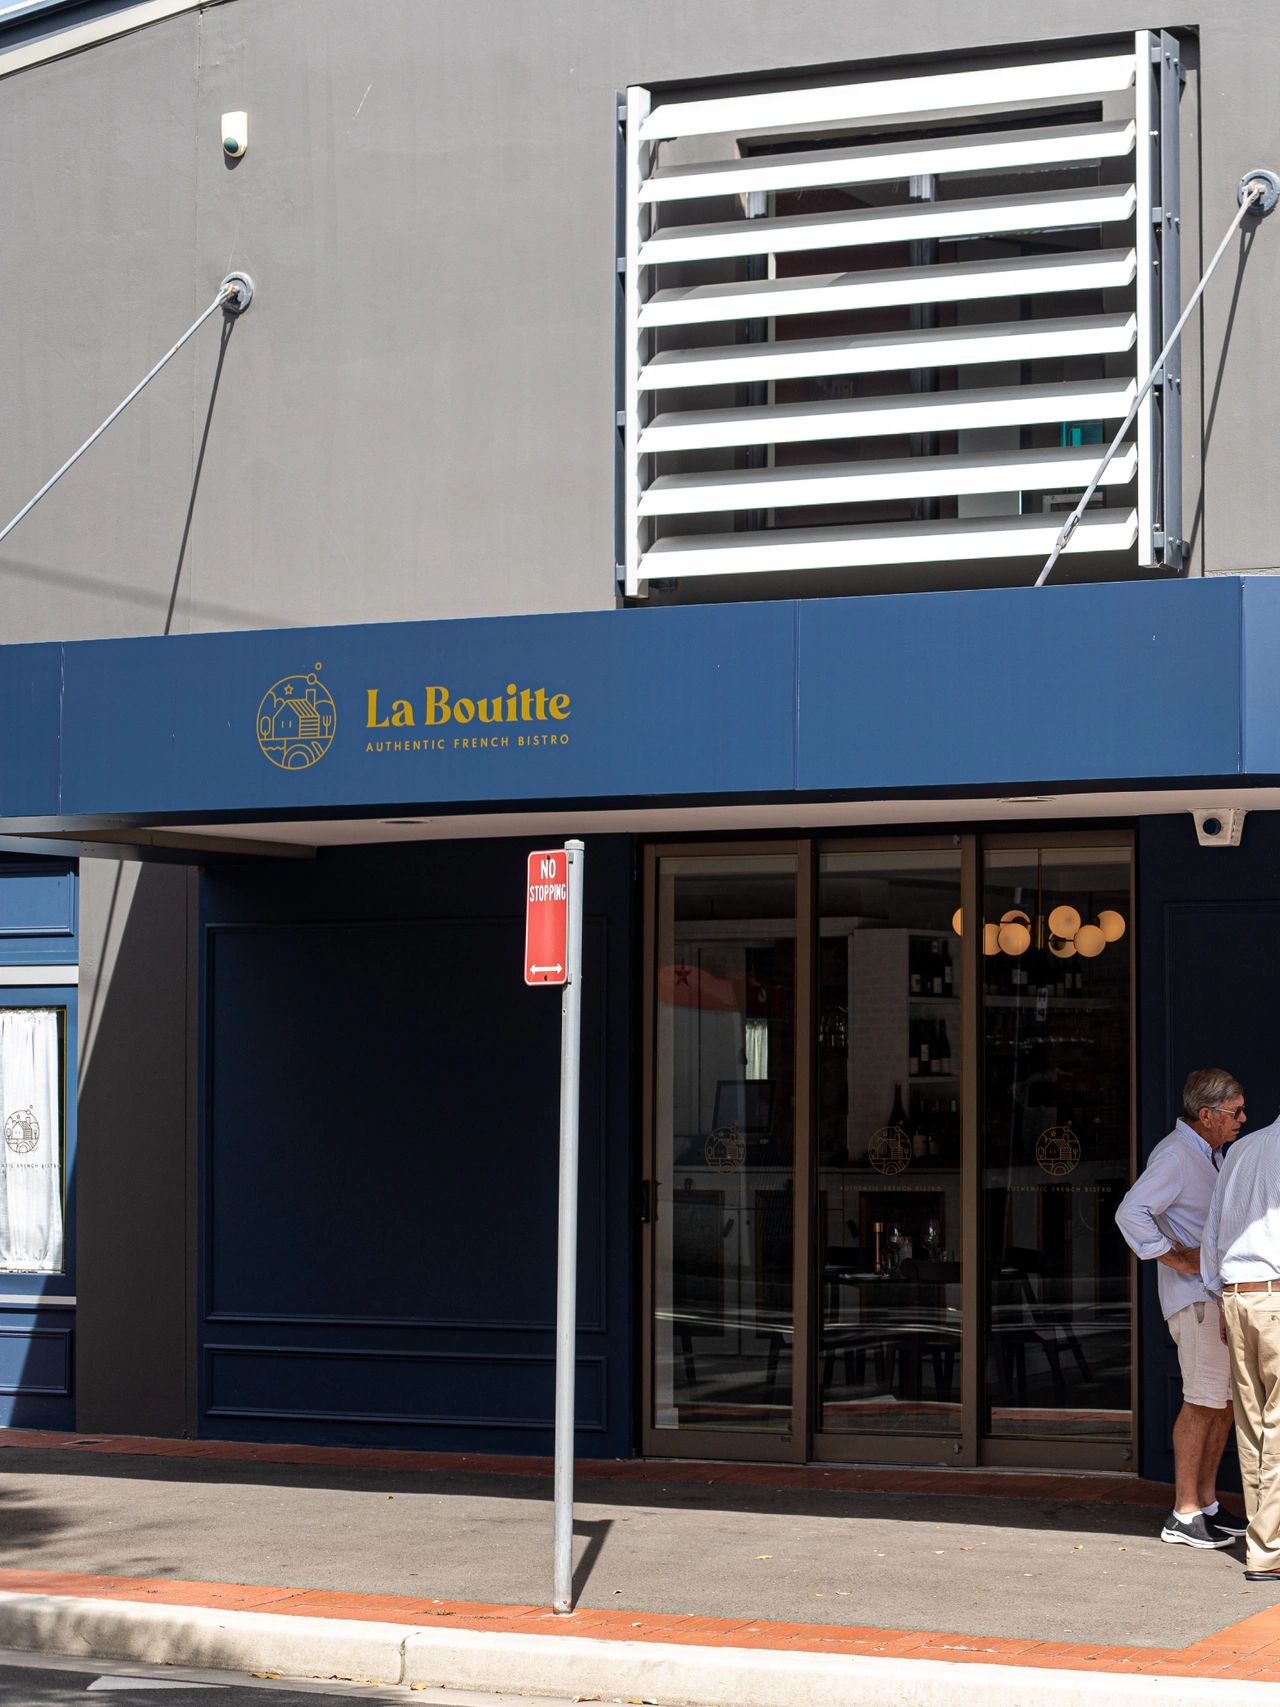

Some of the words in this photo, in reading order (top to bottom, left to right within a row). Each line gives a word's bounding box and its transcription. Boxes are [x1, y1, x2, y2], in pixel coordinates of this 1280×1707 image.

[366, 688, 416, 728] La
[424, 683, 572, 726] Bouitte
[366, 739, 445, 752] AUTHENTIC
[454, 736, 509, 749] FRENCH
[518, 734, 570, 746] BISTRO
[540, 858, 557, 880] NO
[529, 883, 567, 903] STOPPING
